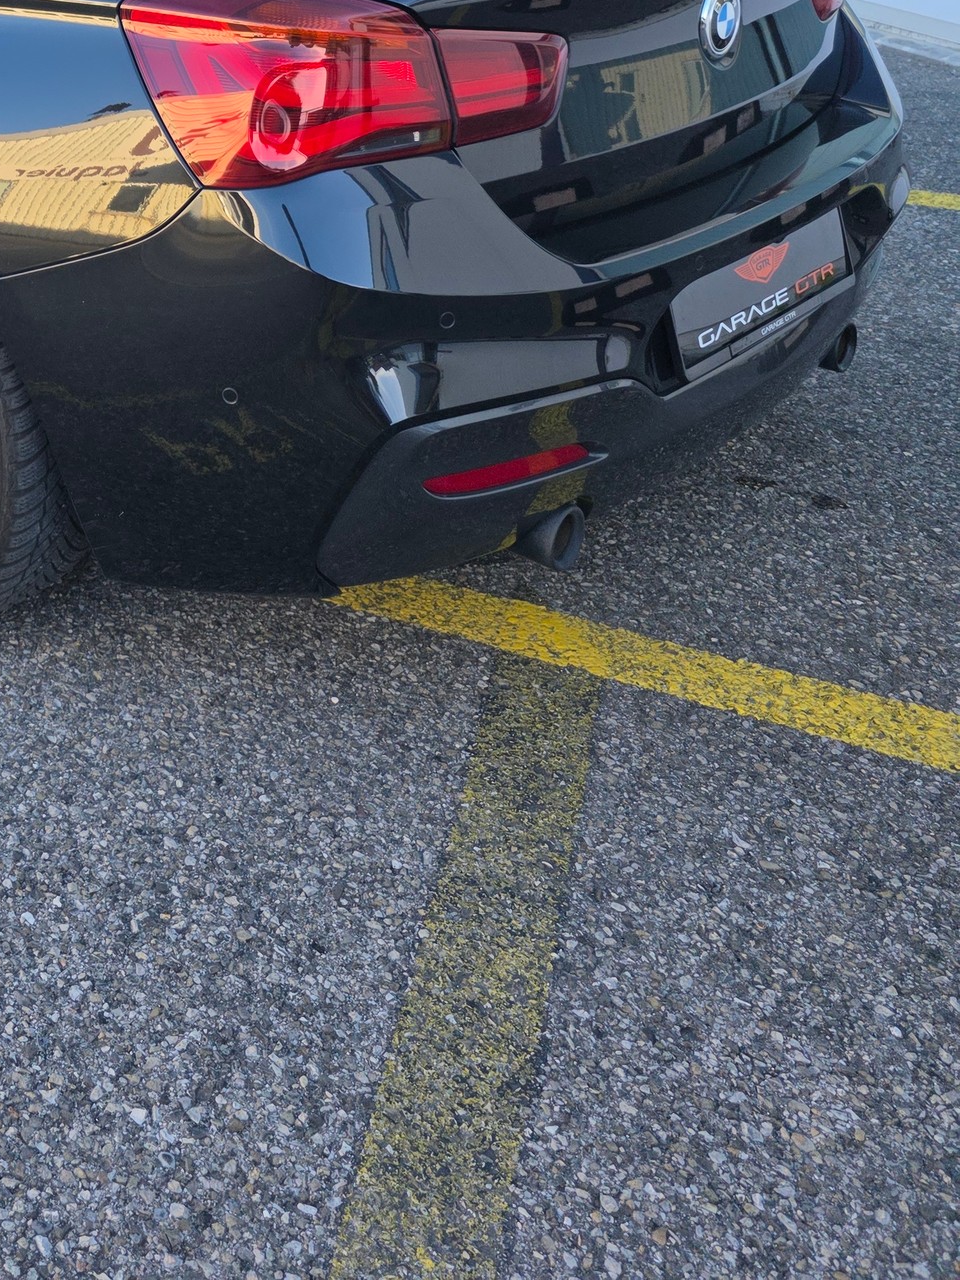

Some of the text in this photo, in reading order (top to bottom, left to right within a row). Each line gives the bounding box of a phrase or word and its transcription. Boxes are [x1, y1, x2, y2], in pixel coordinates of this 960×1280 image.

[755, 258, 771, 270] GTR
[697, 262, 834, 348] GARAGE GTR
[760, 310, 797, 335] GARAGE GTR
